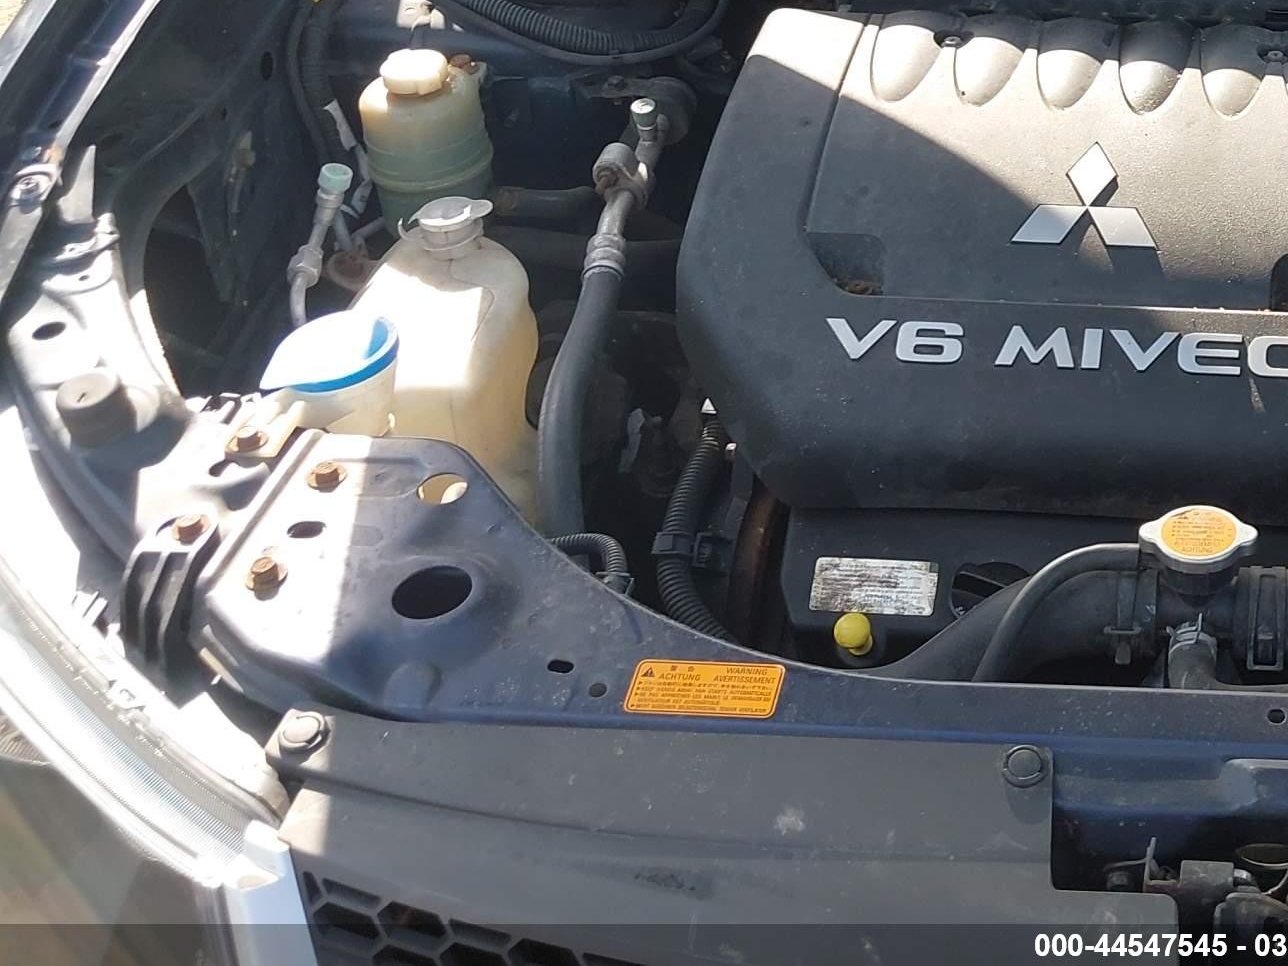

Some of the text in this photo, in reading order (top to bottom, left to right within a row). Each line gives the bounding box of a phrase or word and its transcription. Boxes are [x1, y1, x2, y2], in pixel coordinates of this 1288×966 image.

[825, 317, 964, 364] V6
[726, 666, 768, 675] WARNING
[658, 673, 701, 681] ACHTUNG
[712, 675, 776, 684] AVERTISSEMENT
